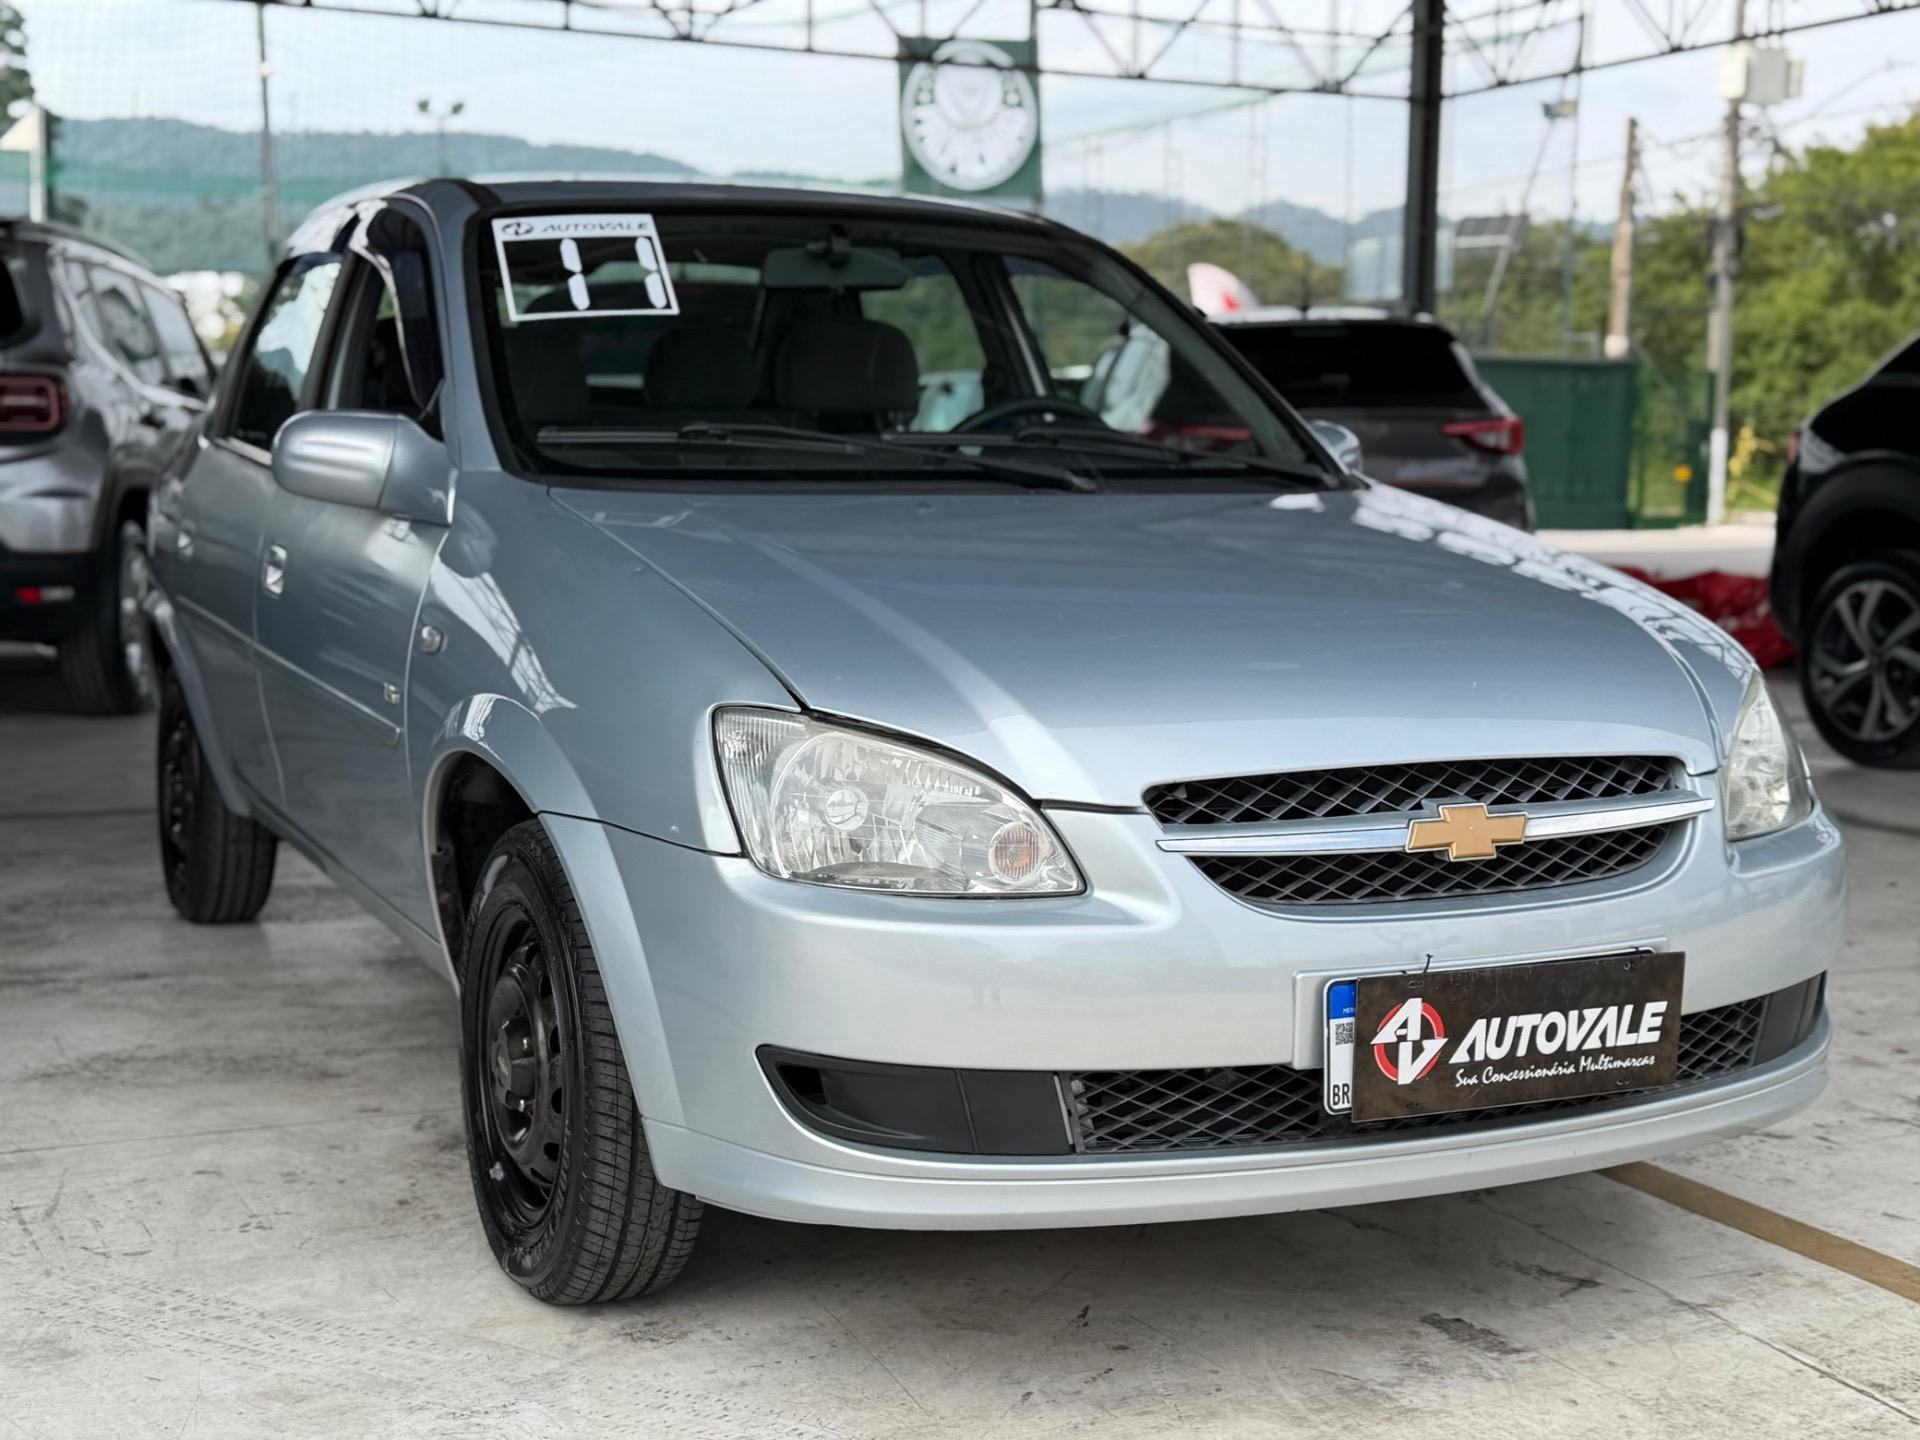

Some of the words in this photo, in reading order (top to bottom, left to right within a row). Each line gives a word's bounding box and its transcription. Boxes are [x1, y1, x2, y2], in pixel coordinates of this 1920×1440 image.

[542, 222, 649, 233] AUTOVALE
[1449, 1001, 1668, 1064] AUTOVALE
[1455, 1068, 1479, 1087] Sua
[1482, 1060, 1576, 1084] Concessionária
[1579, 1054, 1656, 1073] Multimarcas
[1332, 1083, 1350, 1106] BR
